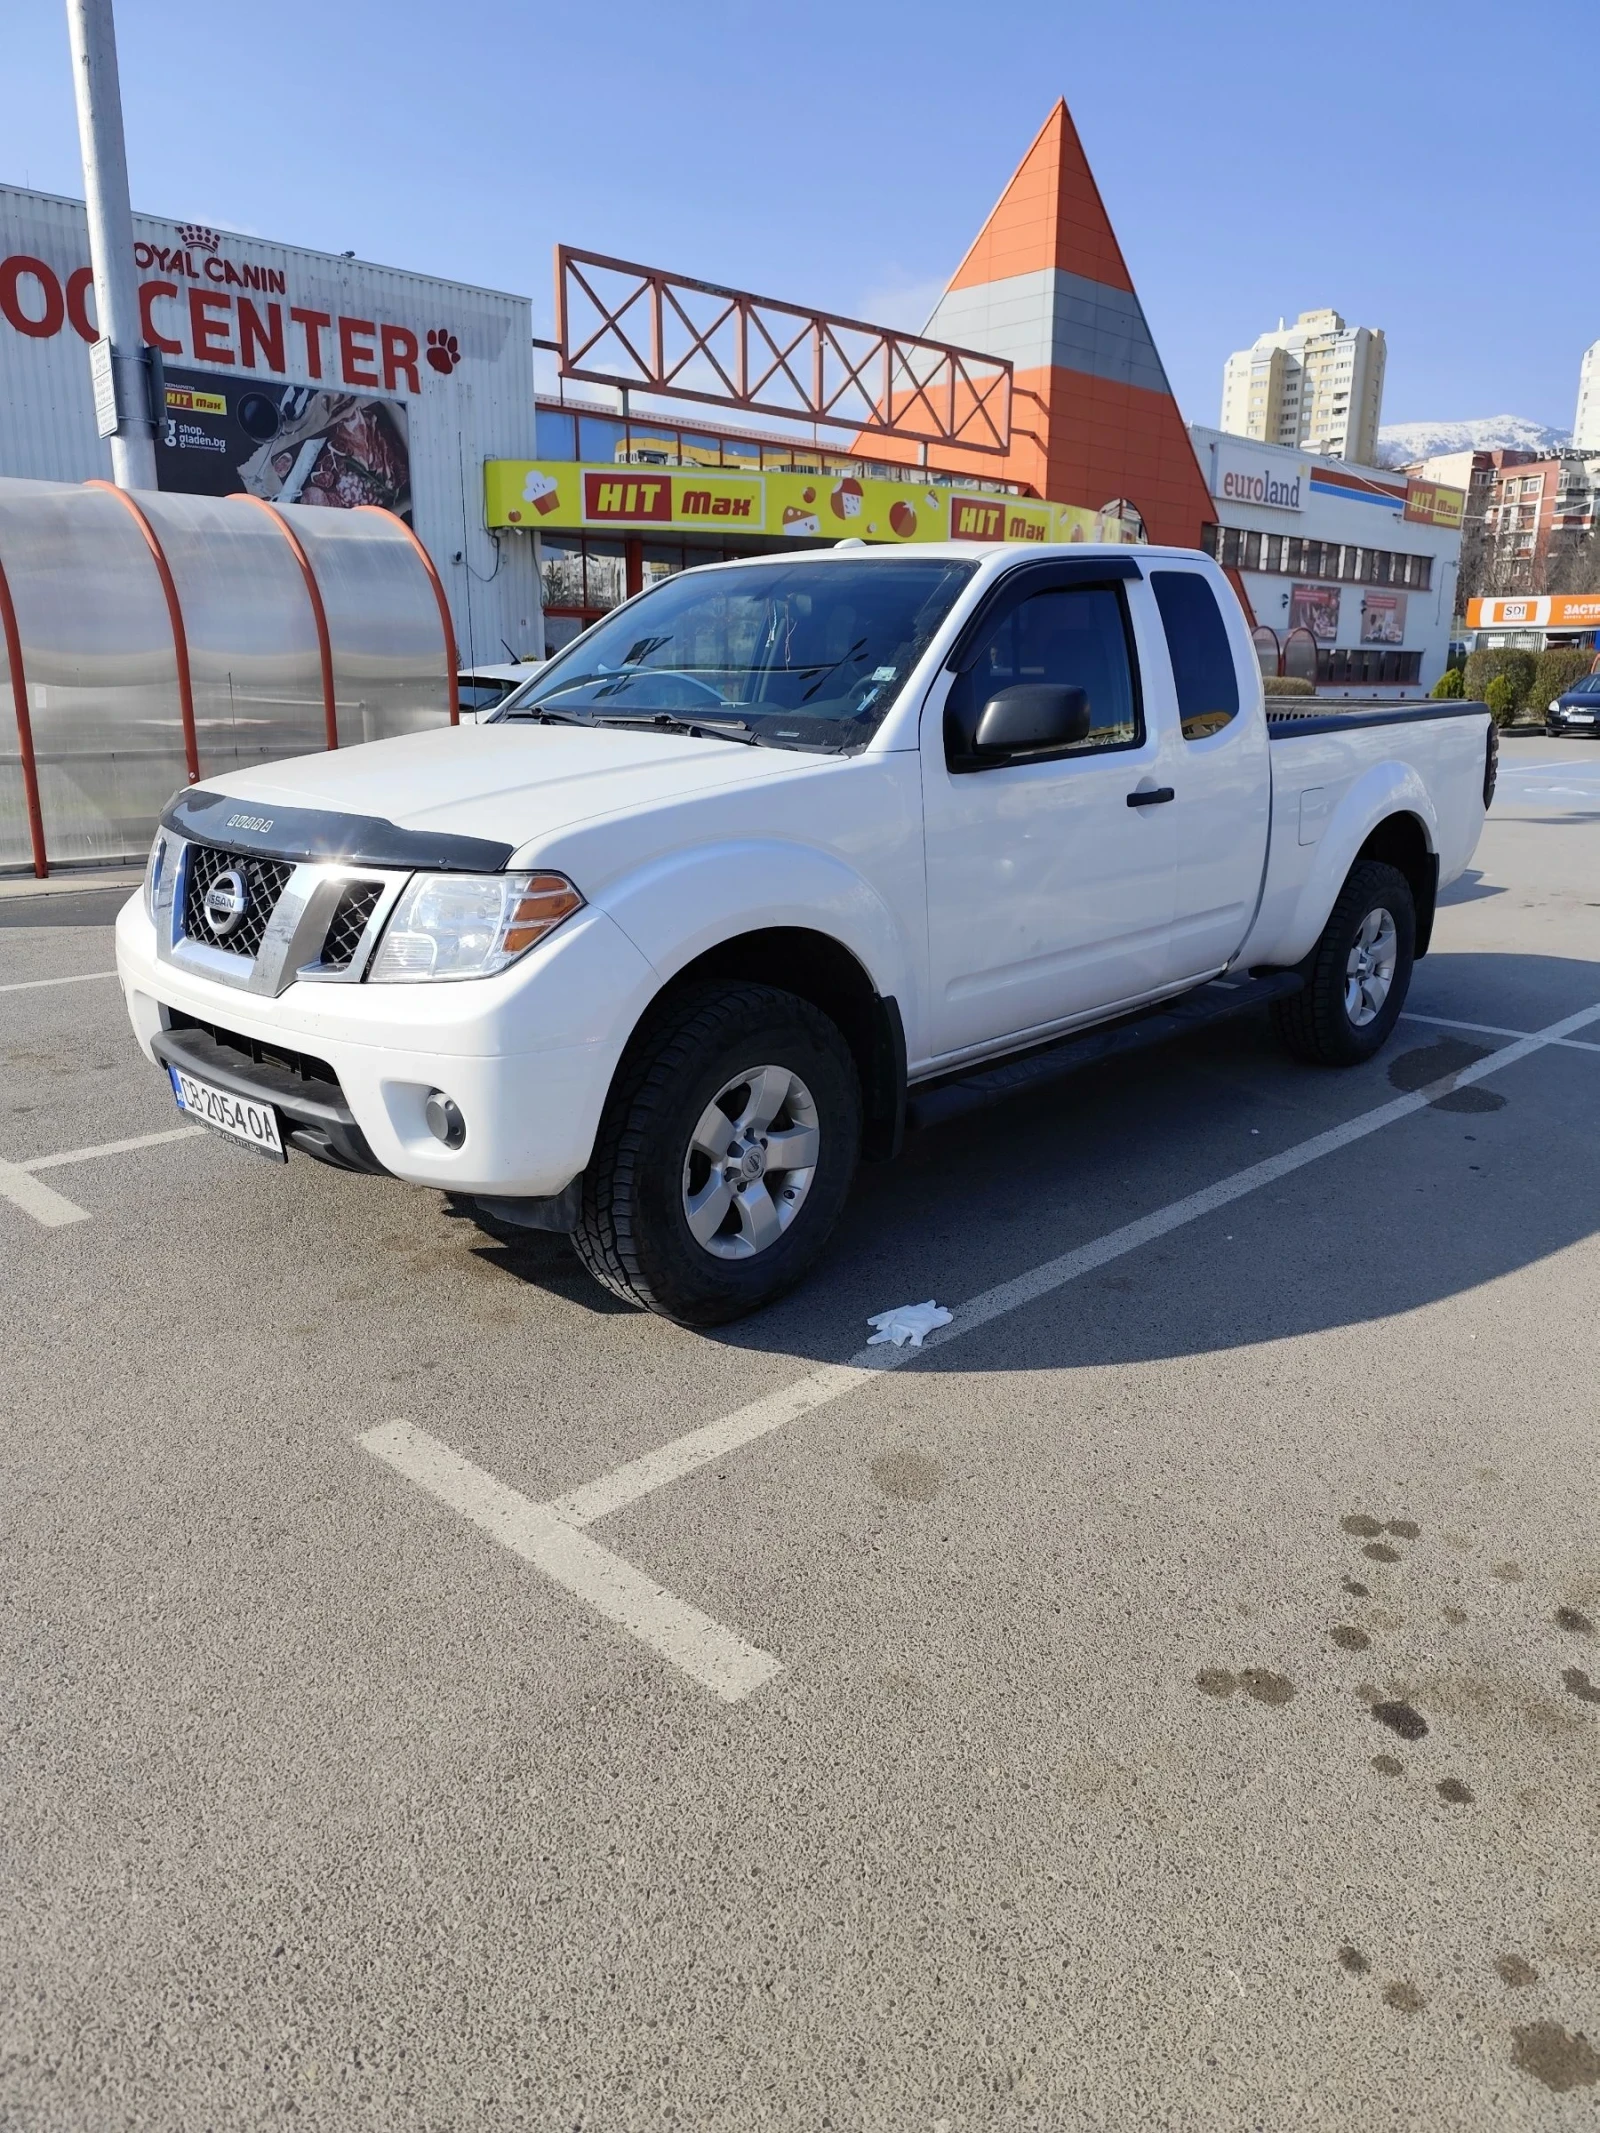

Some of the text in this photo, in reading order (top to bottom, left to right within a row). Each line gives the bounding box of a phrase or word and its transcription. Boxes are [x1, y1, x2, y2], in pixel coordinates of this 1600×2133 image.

[134, 242, 286, 295] OYAL CANIN
[138, 280, 421, 394] CENTER
[167, 392, 189, 406] HIT
[179, 424, 205, 436] shop.
[179, 434, 226, 453] gladen.bg
[597, 483, 662, 513] HIT
[1223, 470, 1301, 508] euroland
[1411, 490, 1433, 514] HIT
[959, 507, 1000, 535] HIT
[1505, 606, 1525, 616] SDI
